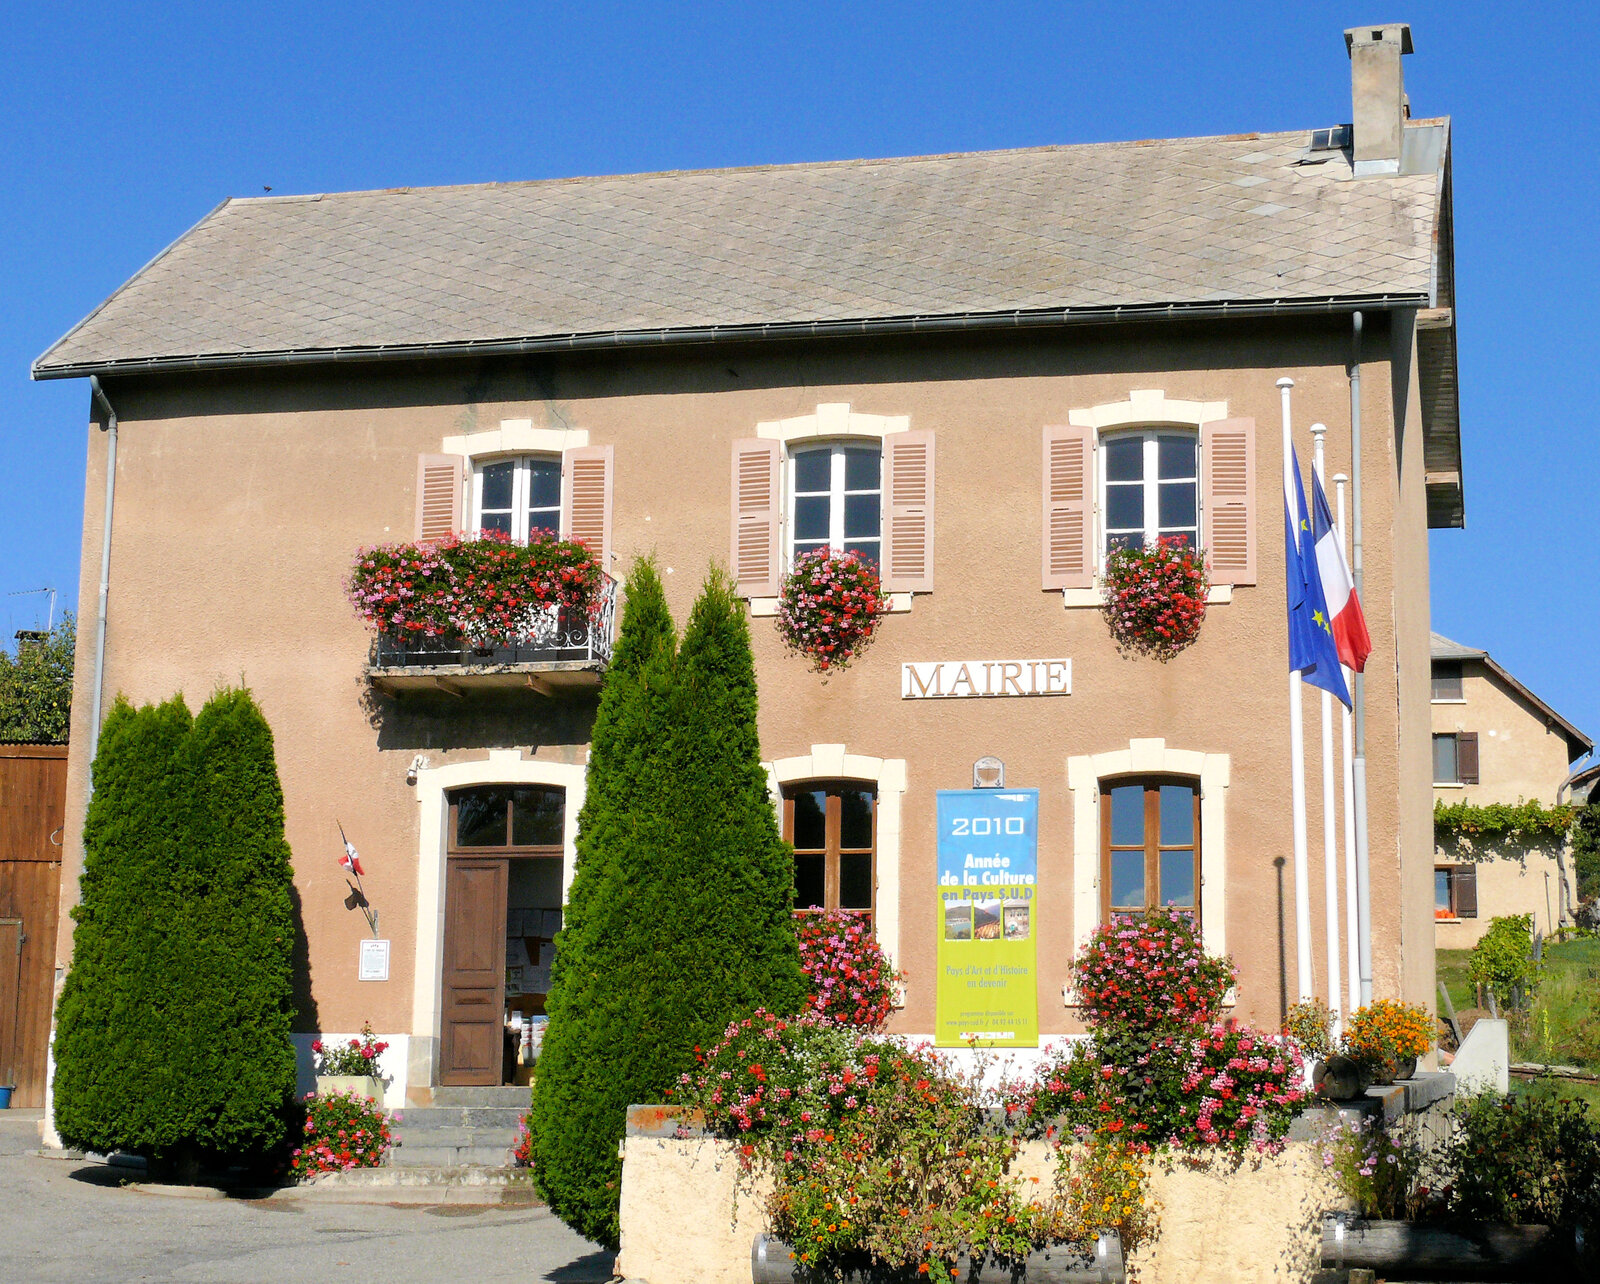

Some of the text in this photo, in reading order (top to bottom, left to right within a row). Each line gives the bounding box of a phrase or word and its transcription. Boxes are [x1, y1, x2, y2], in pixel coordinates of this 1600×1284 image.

[905, 660, 1067, 697] MAIRIE
[951, 817, 1024, 836] 2010
[964, 853, 1010, 868] Année
[940, 869, 1035, 886] de la Culture
[941, 892, 958, 901] en
[963, 888, 994, 903] Pays
[946, 964, 1028, 977] Pays d'Art et d'Histoire
[967, 977, 1007, 988] en devenir
